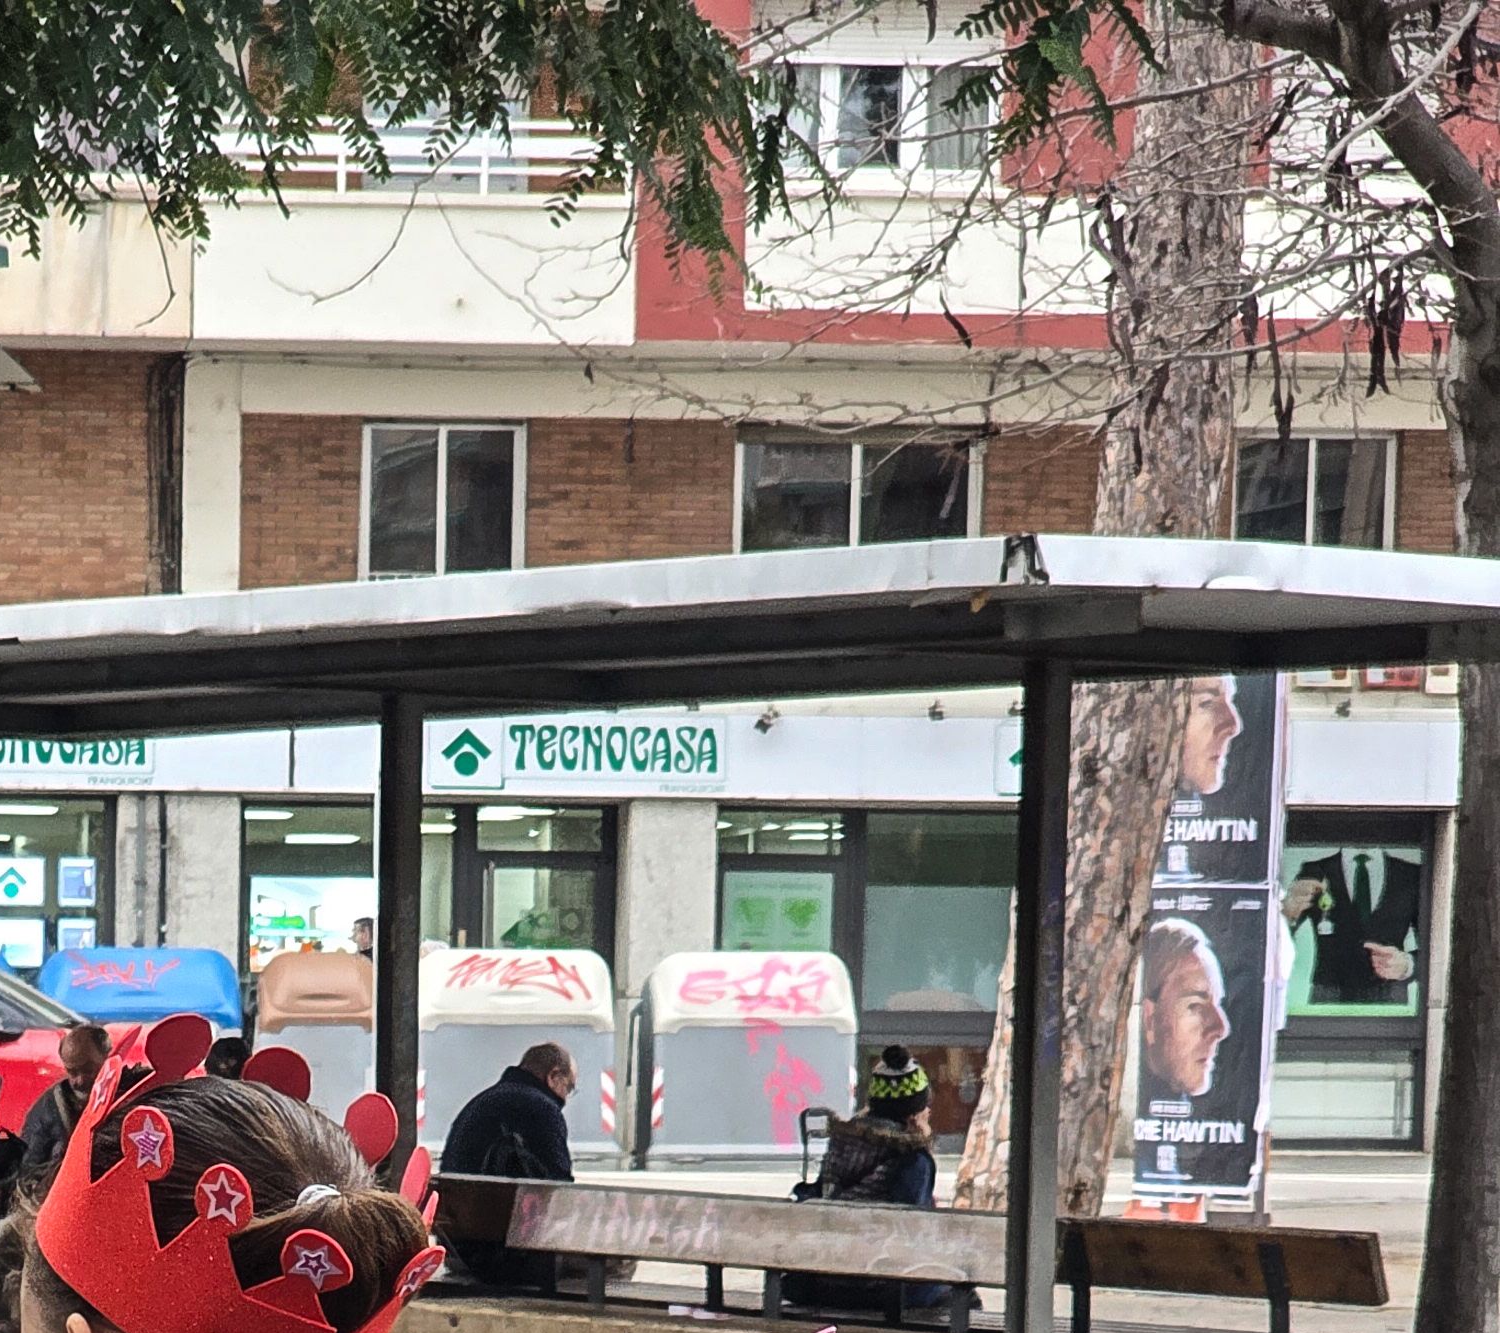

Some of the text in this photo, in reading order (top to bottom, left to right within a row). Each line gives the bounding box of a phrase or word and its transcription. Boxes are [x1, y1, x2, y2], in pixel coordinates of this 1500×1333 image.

[509, 724, 718, 773] TECNOCASA
[1173, 818, 1258, 842] HAWTIN
[1162, 1120, 1245, 1144] HAWTIN
